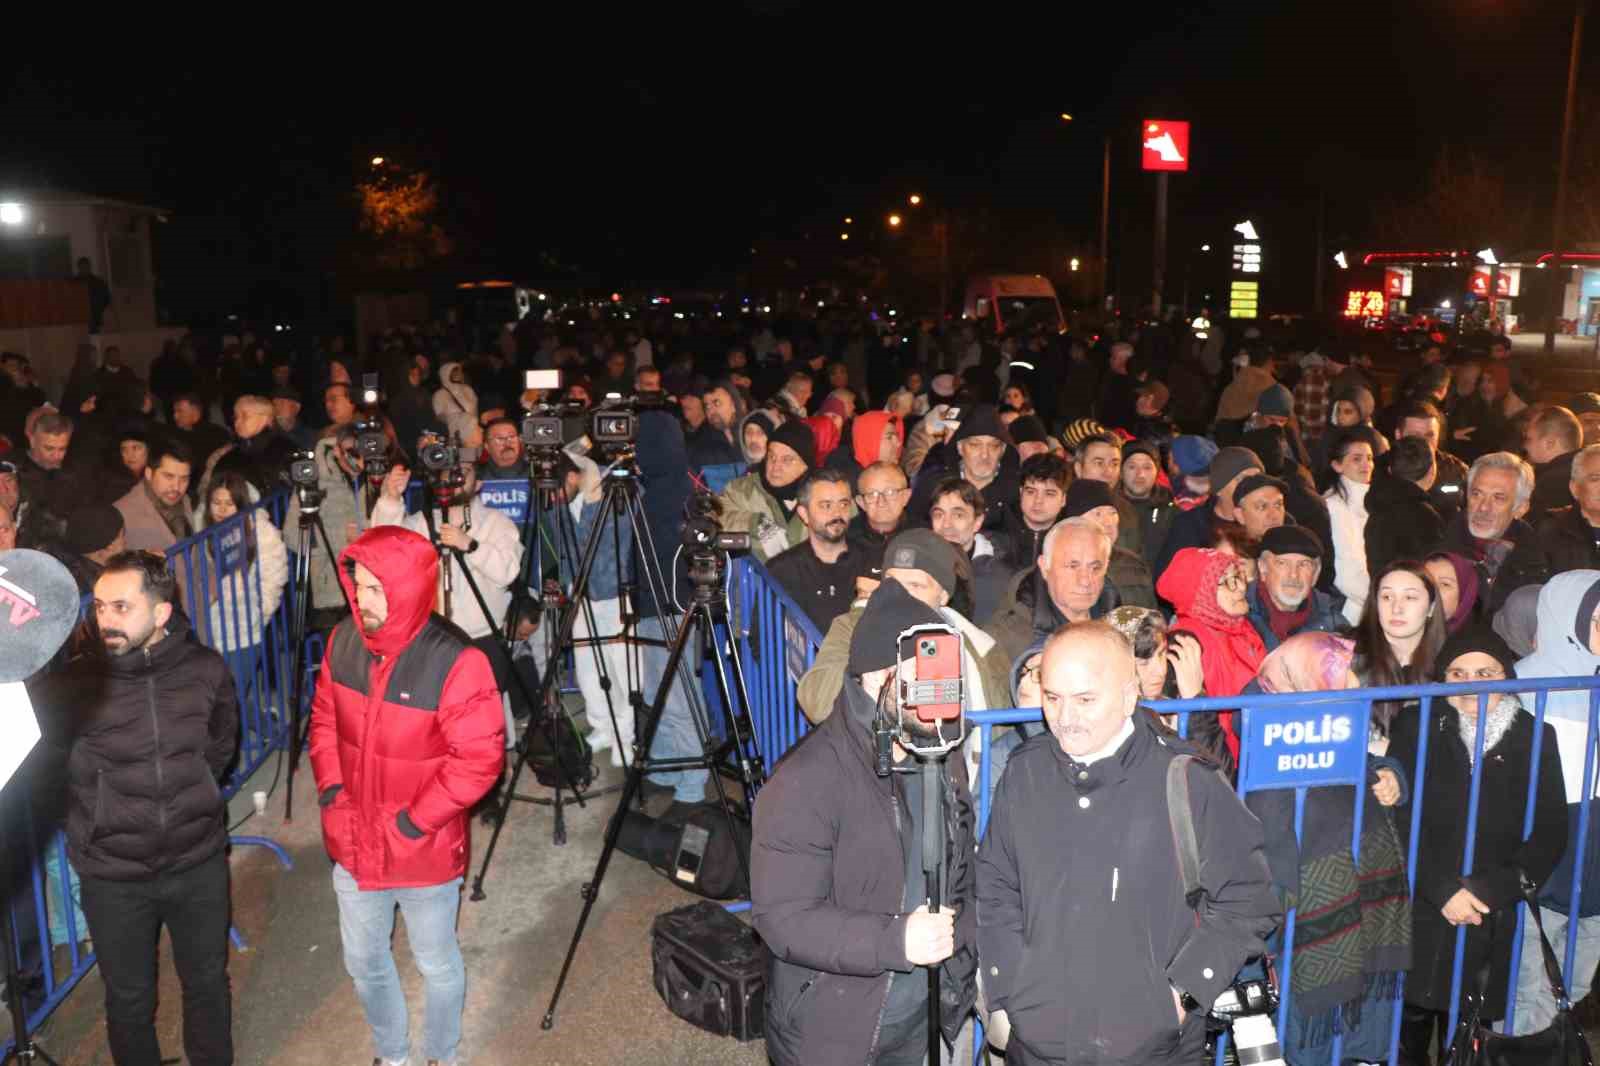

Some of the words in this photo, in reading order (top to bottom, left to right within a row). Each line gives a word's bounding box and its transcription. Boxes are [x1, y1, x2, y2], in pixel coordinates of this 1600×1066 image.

[481, 489, 528, 505] POLİS
[1264, 714, 1352, 747] POLİS
[1278, 750, 1336, 771] BOLU
